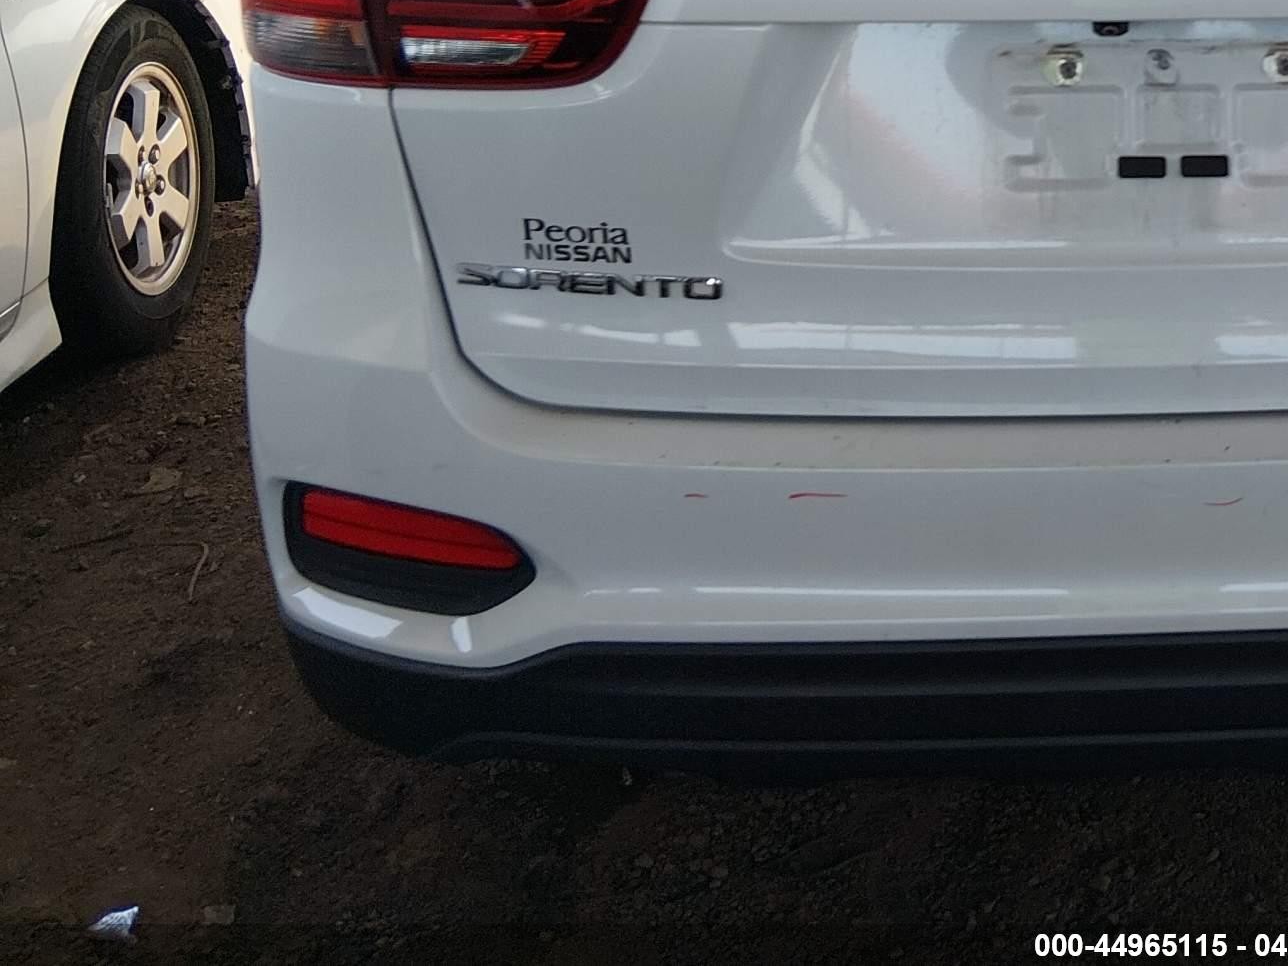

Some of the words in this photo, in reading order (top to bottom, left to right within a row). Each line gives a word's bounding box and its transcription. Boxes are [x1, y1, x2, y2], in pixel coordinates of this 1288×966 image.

[522, 217, 629, 246] Peoria
[523, 242, 633, 264] NISSAN
[456, 263, 723, 300] SORENTO
